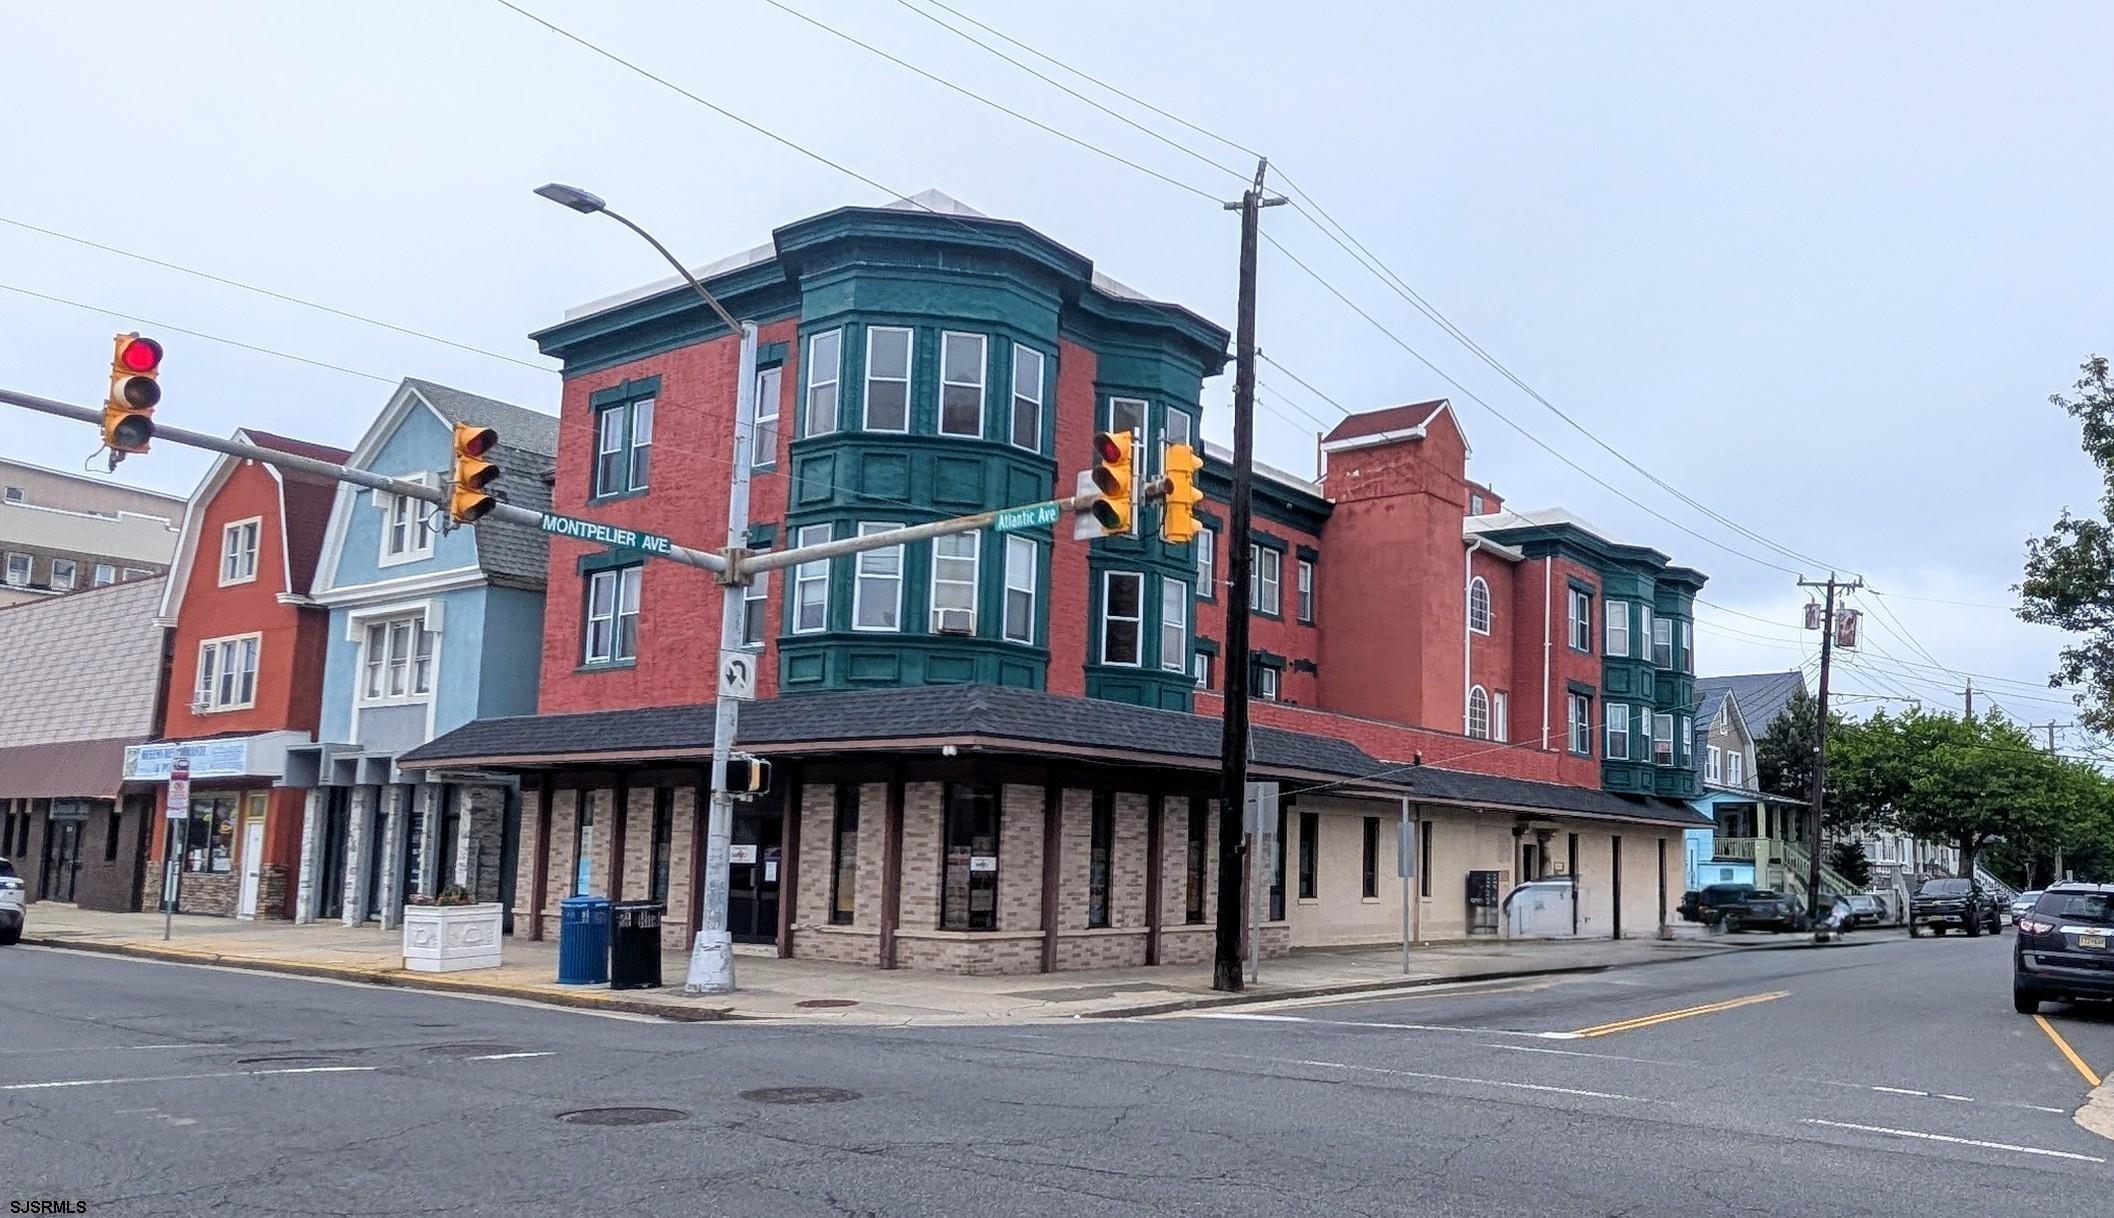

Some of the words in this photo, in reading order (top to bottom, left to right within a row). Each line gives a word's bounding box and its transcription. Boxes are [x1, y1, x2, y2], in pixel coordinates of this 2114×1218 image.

[542, 514, 637, 547] MONTPELIER
[998, 511, 1035, 530] Atlantic
[1038, 507, 1056, 524] Ave
